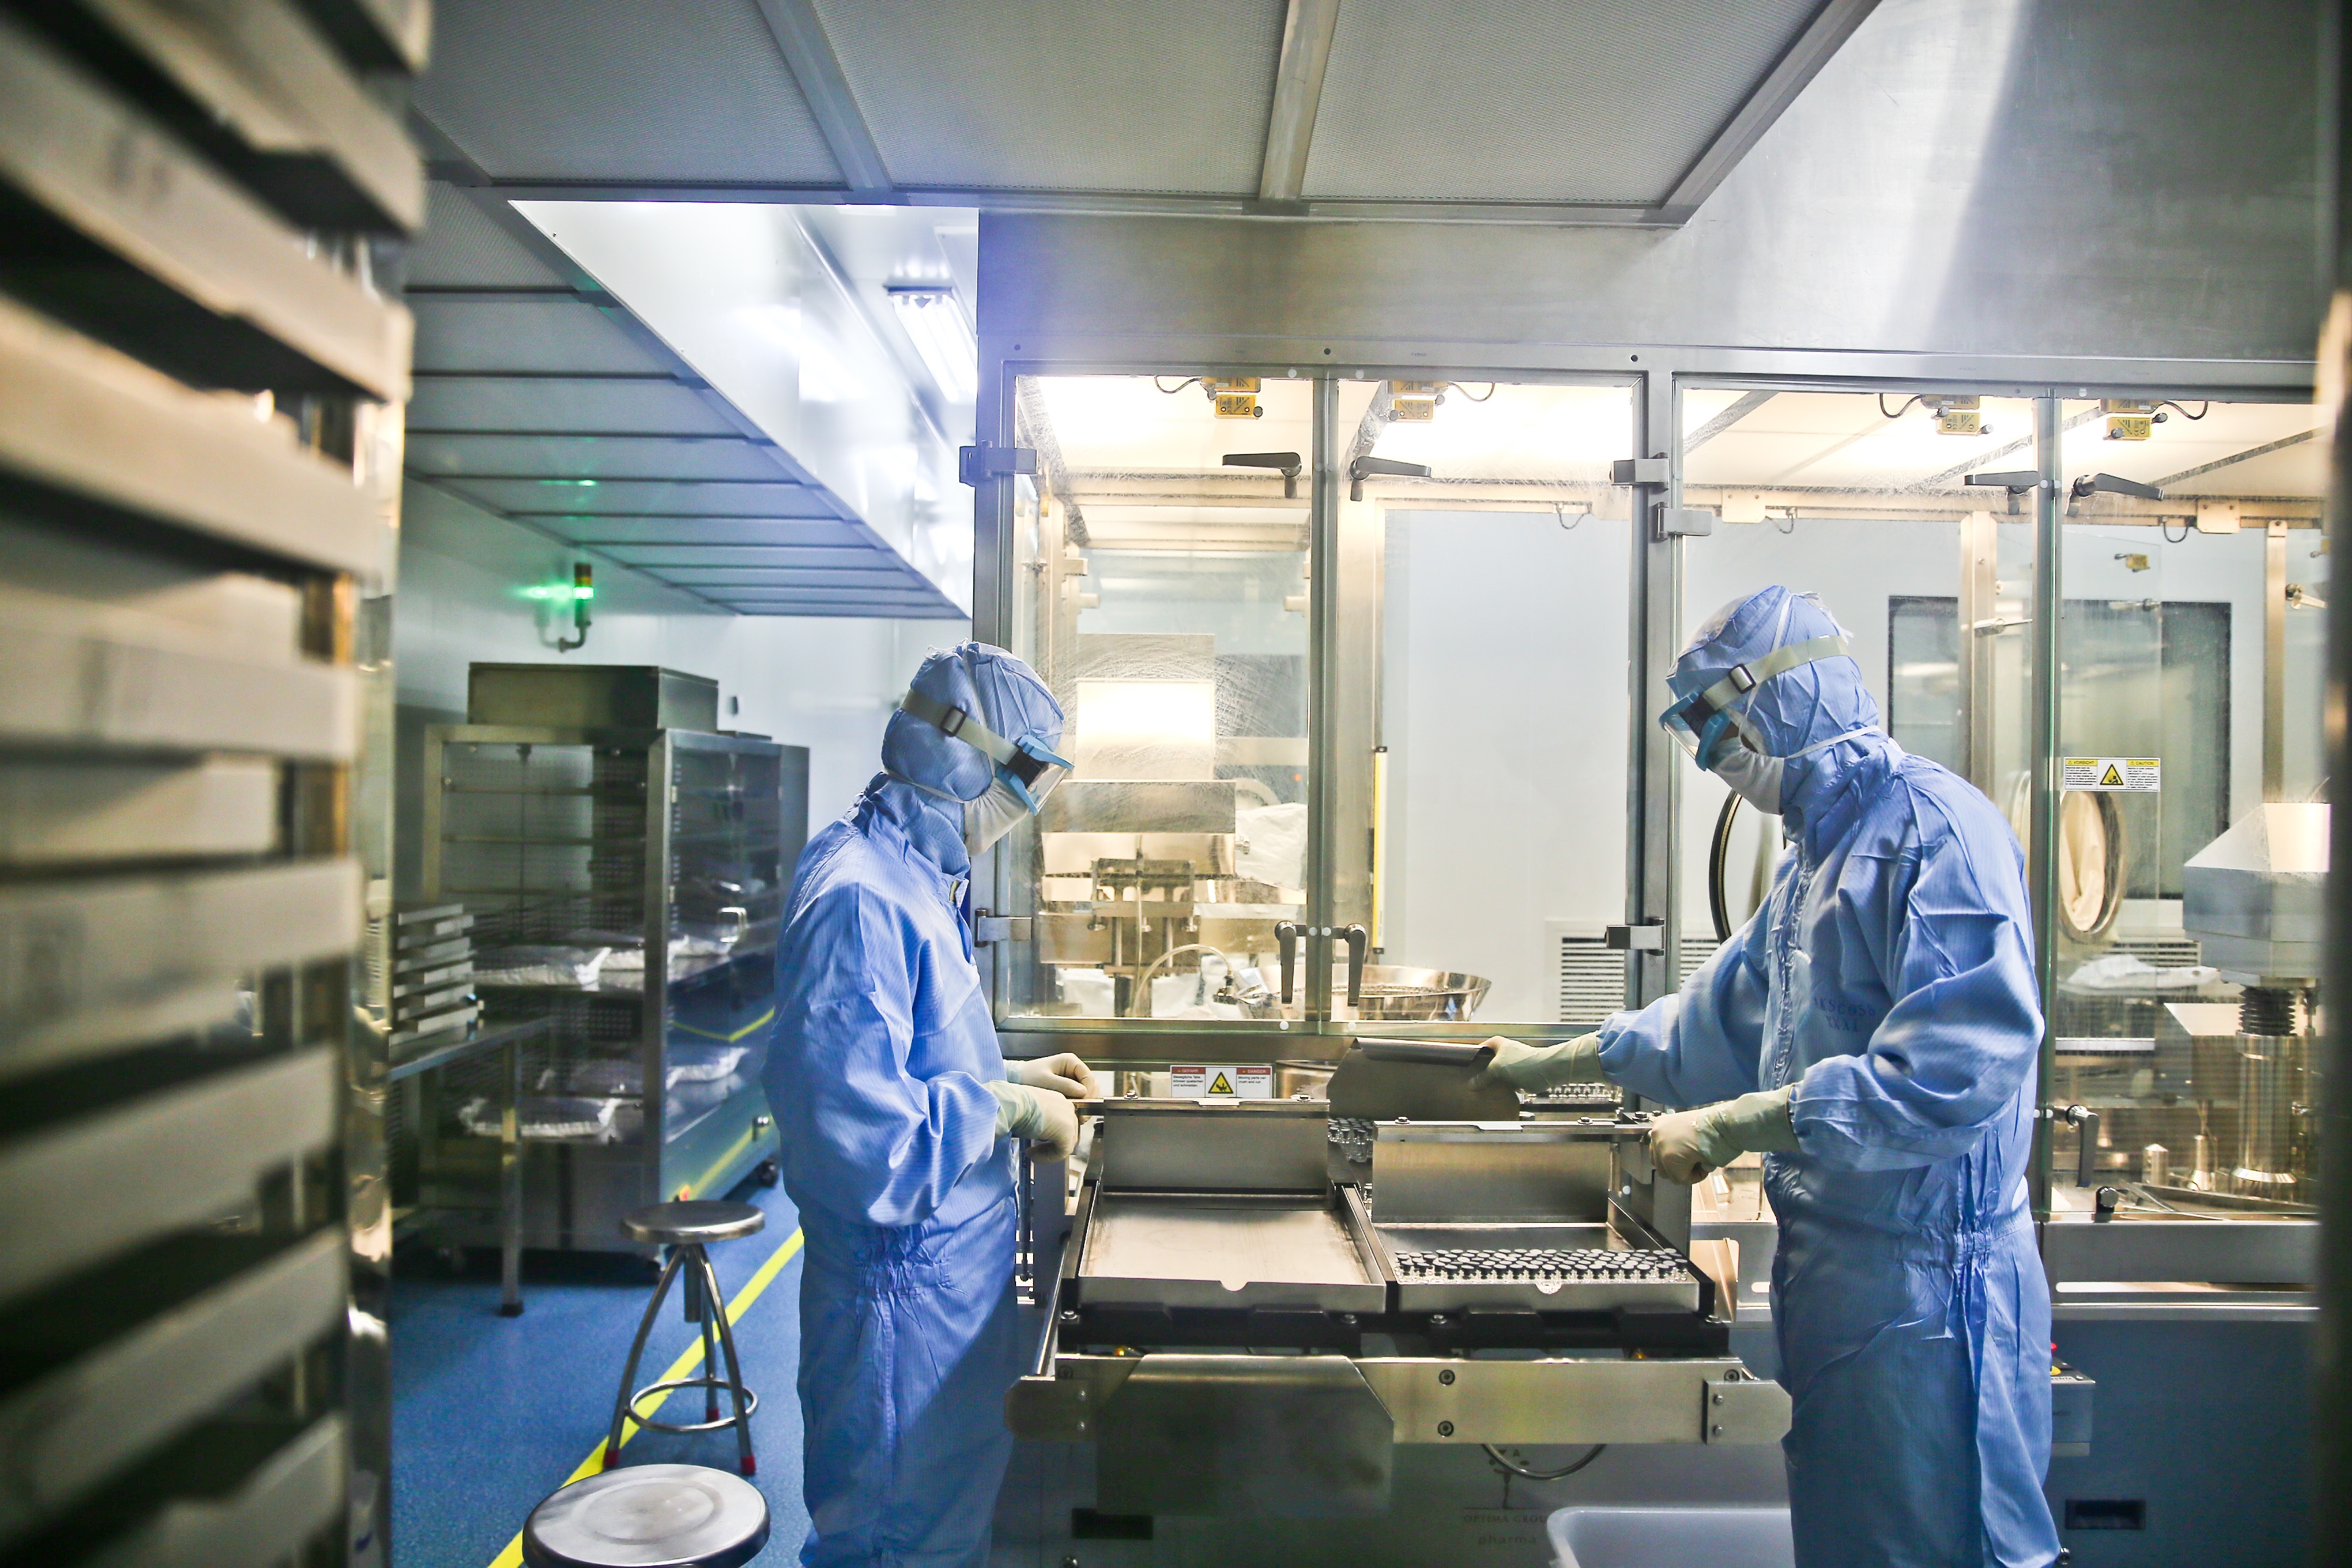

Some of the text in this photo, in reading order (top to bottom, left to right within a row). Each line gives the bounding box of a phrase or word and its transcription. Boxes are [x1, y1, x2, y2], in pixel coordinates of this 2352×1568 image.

[1464, 1514, 1548, 1523] OPTIMA GROU
[1477, 1535, 1537, 1546] pharma
